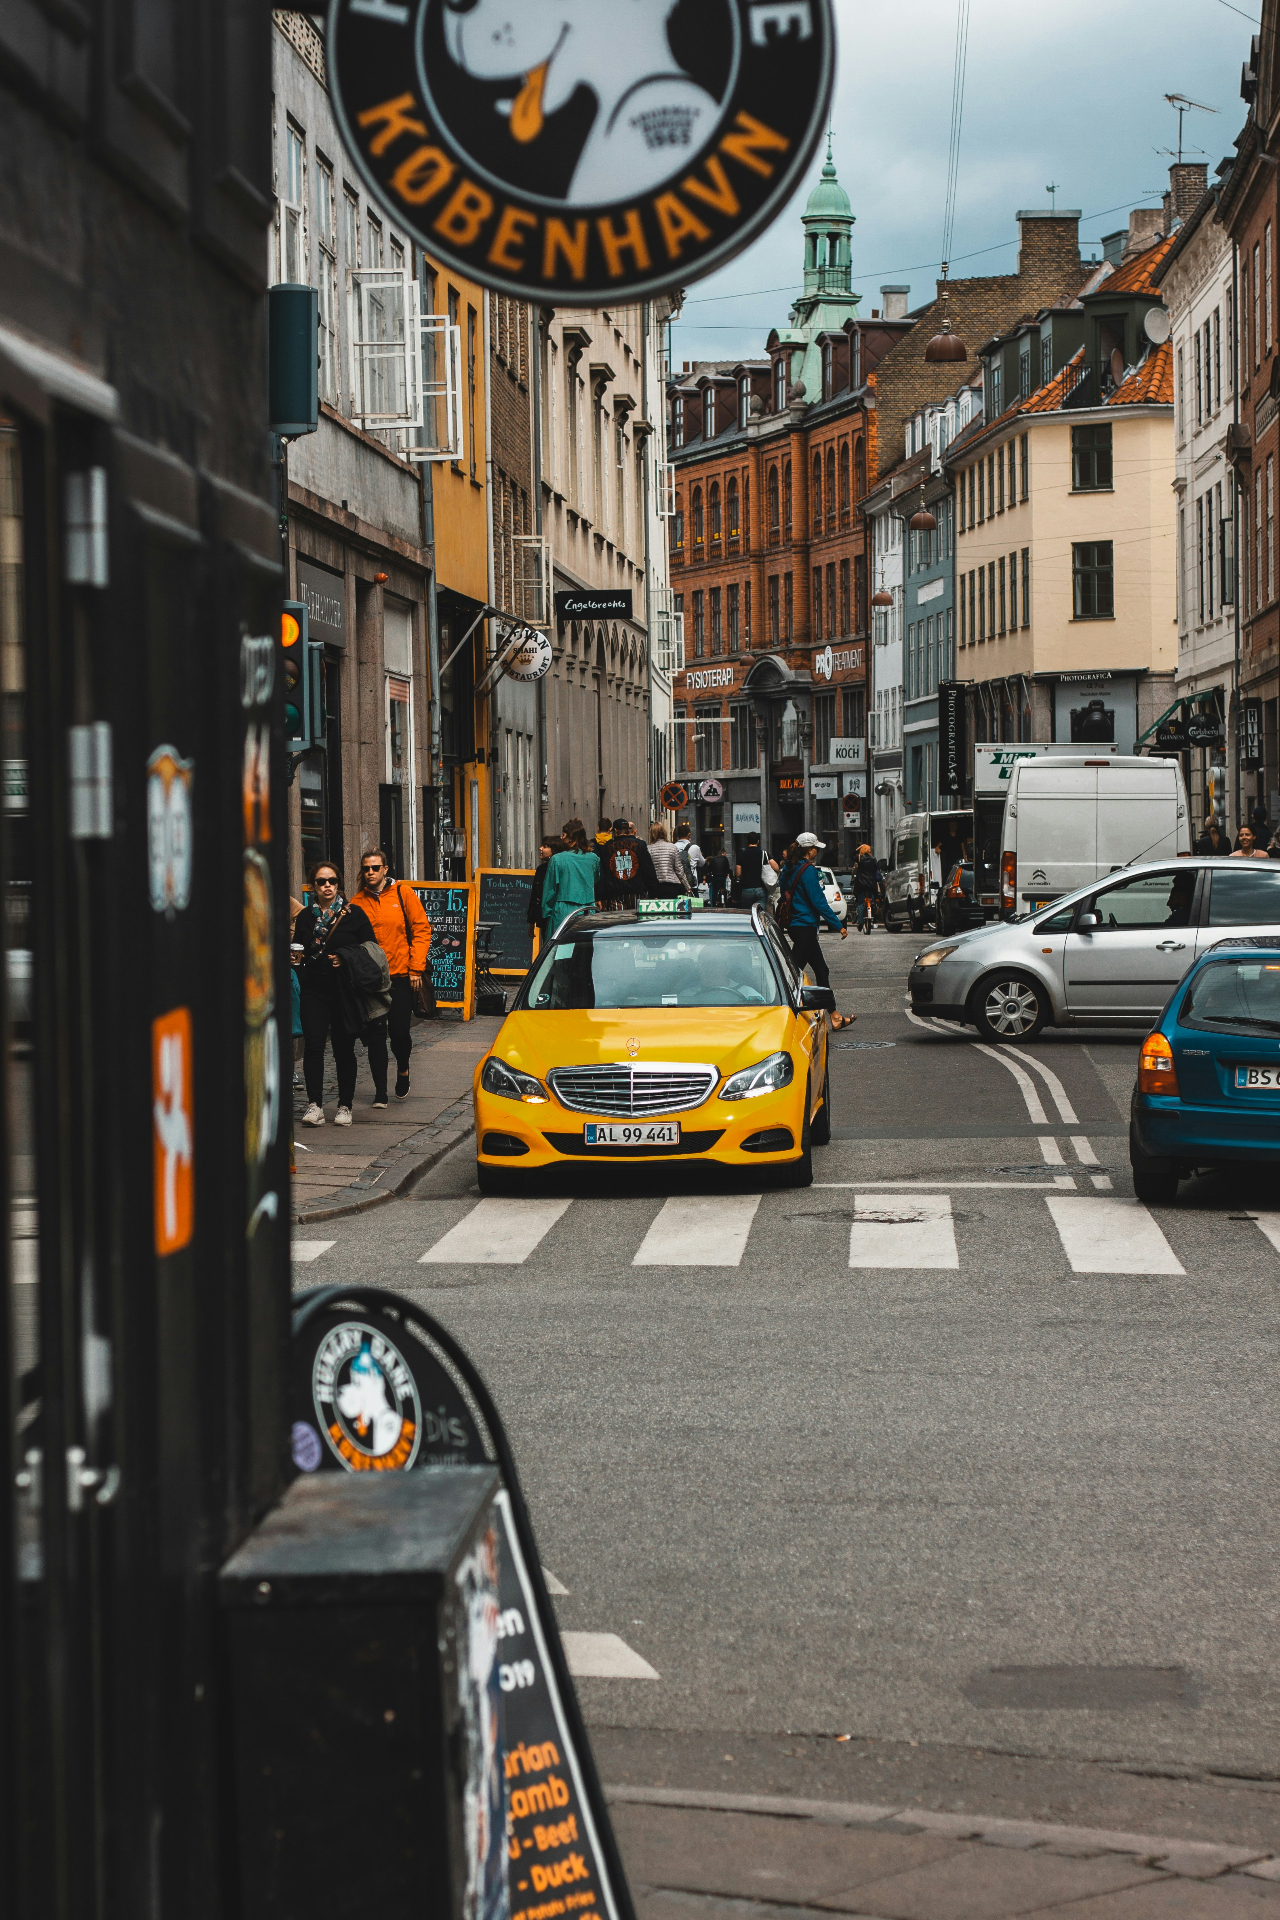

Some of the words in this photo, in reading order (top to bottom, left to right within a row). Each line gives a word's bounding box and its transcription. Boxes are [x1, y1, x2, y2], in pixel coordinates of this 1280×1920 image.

[357, 92, 790, 282] KØBENHAVN
[501, 655, 550, 681] RSTAURANT
[686, 667, 734, 690] FYSIOTERAPI
[1060, 671, 1113, 682] PHOTOGRAFICA
[948, 690, 958, 769] PHOTOGRAFICA
[1188, 726, 1219, 738] Carlsberg
[1248, 709, 1259, 758] HIVE
[835, 747, 860, 759] KOCH
[425, 901, 441, 911] GO
[639, 901, 675, 912] TAXI
[597, 1127, 618, 1142] AL
[622, 1127, 642, 1143] 99
[646, 1126, 675, 1142] 441
[370, 1335, 414, 1401] DANE
[507, 1773, 570, 1821] amb
